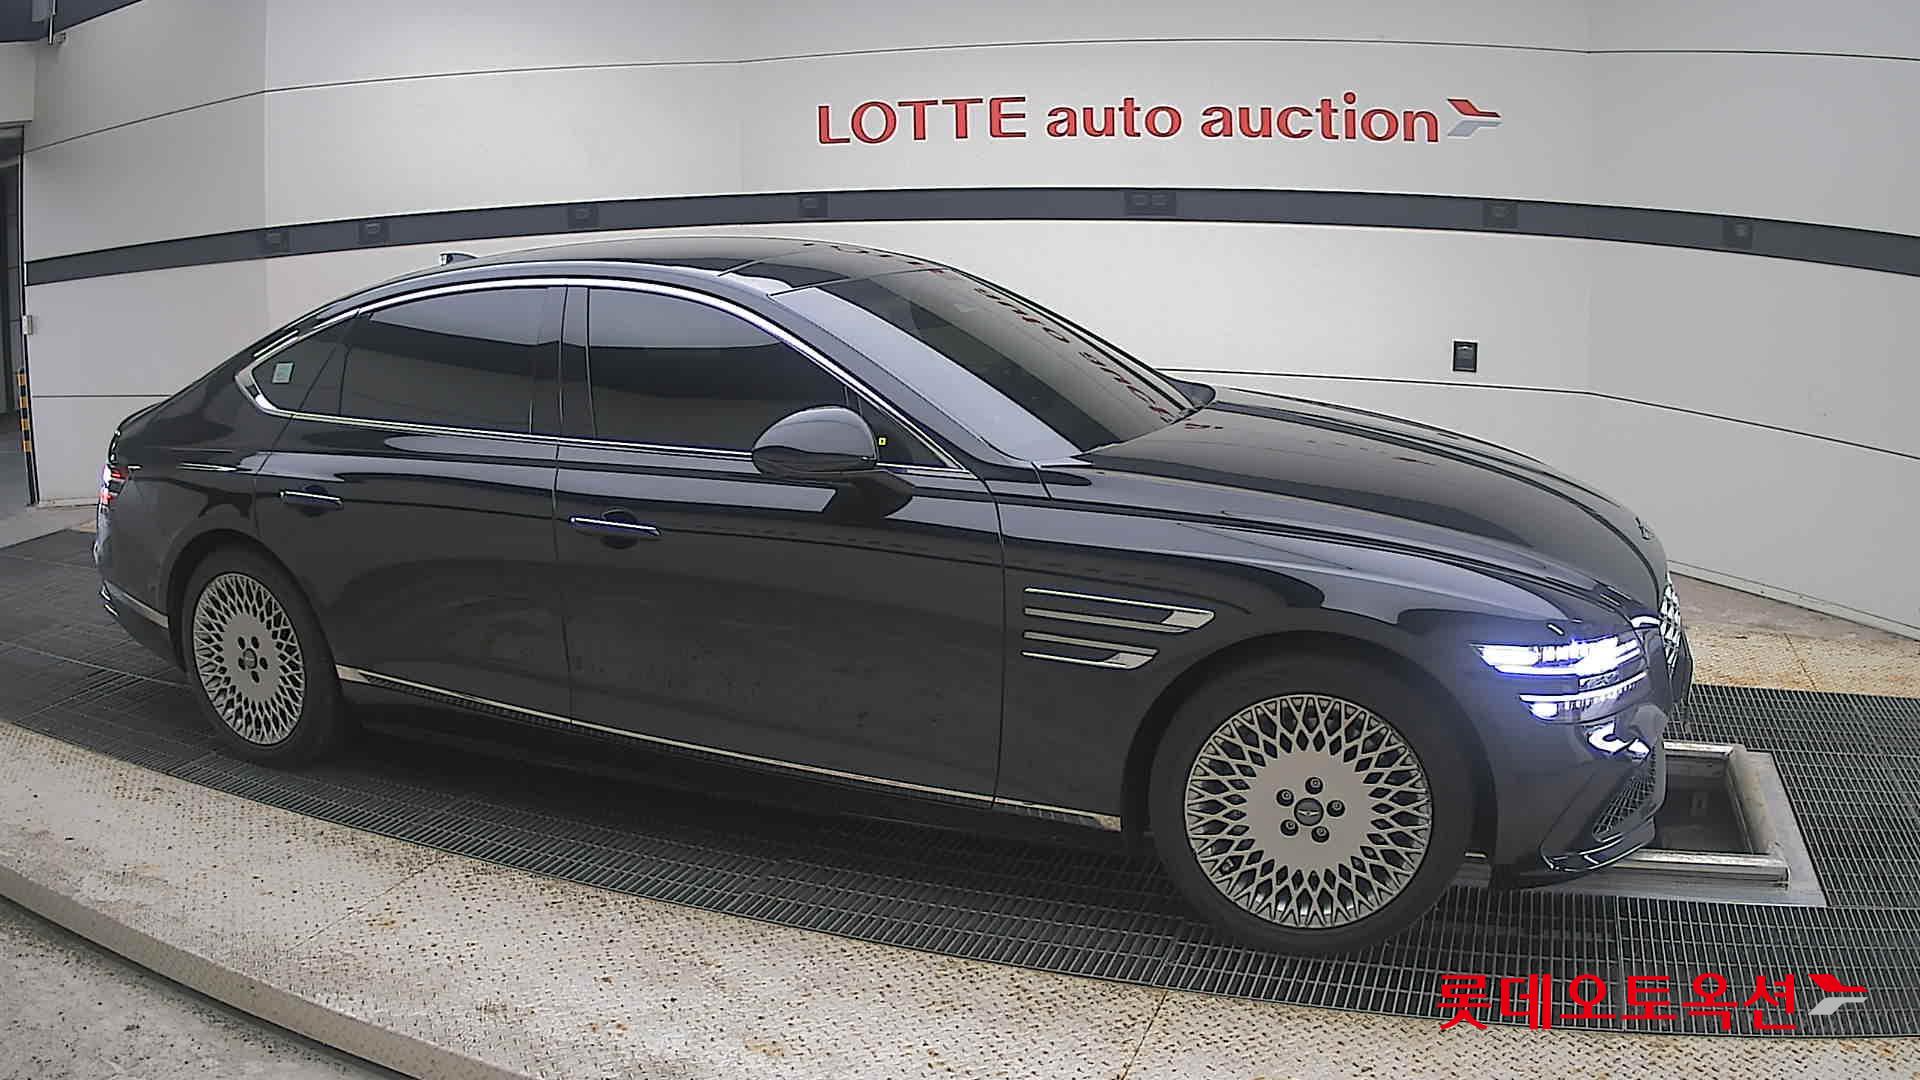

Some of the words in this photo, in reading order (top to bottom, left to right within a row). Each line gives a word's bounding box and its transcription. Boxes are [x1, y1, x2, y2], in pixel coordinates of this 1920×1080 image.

[817, 96, 1026, 145] LOTTE
[1046, 97, 1184, 138] auto
[1200, 91, 1440, 144] auction
